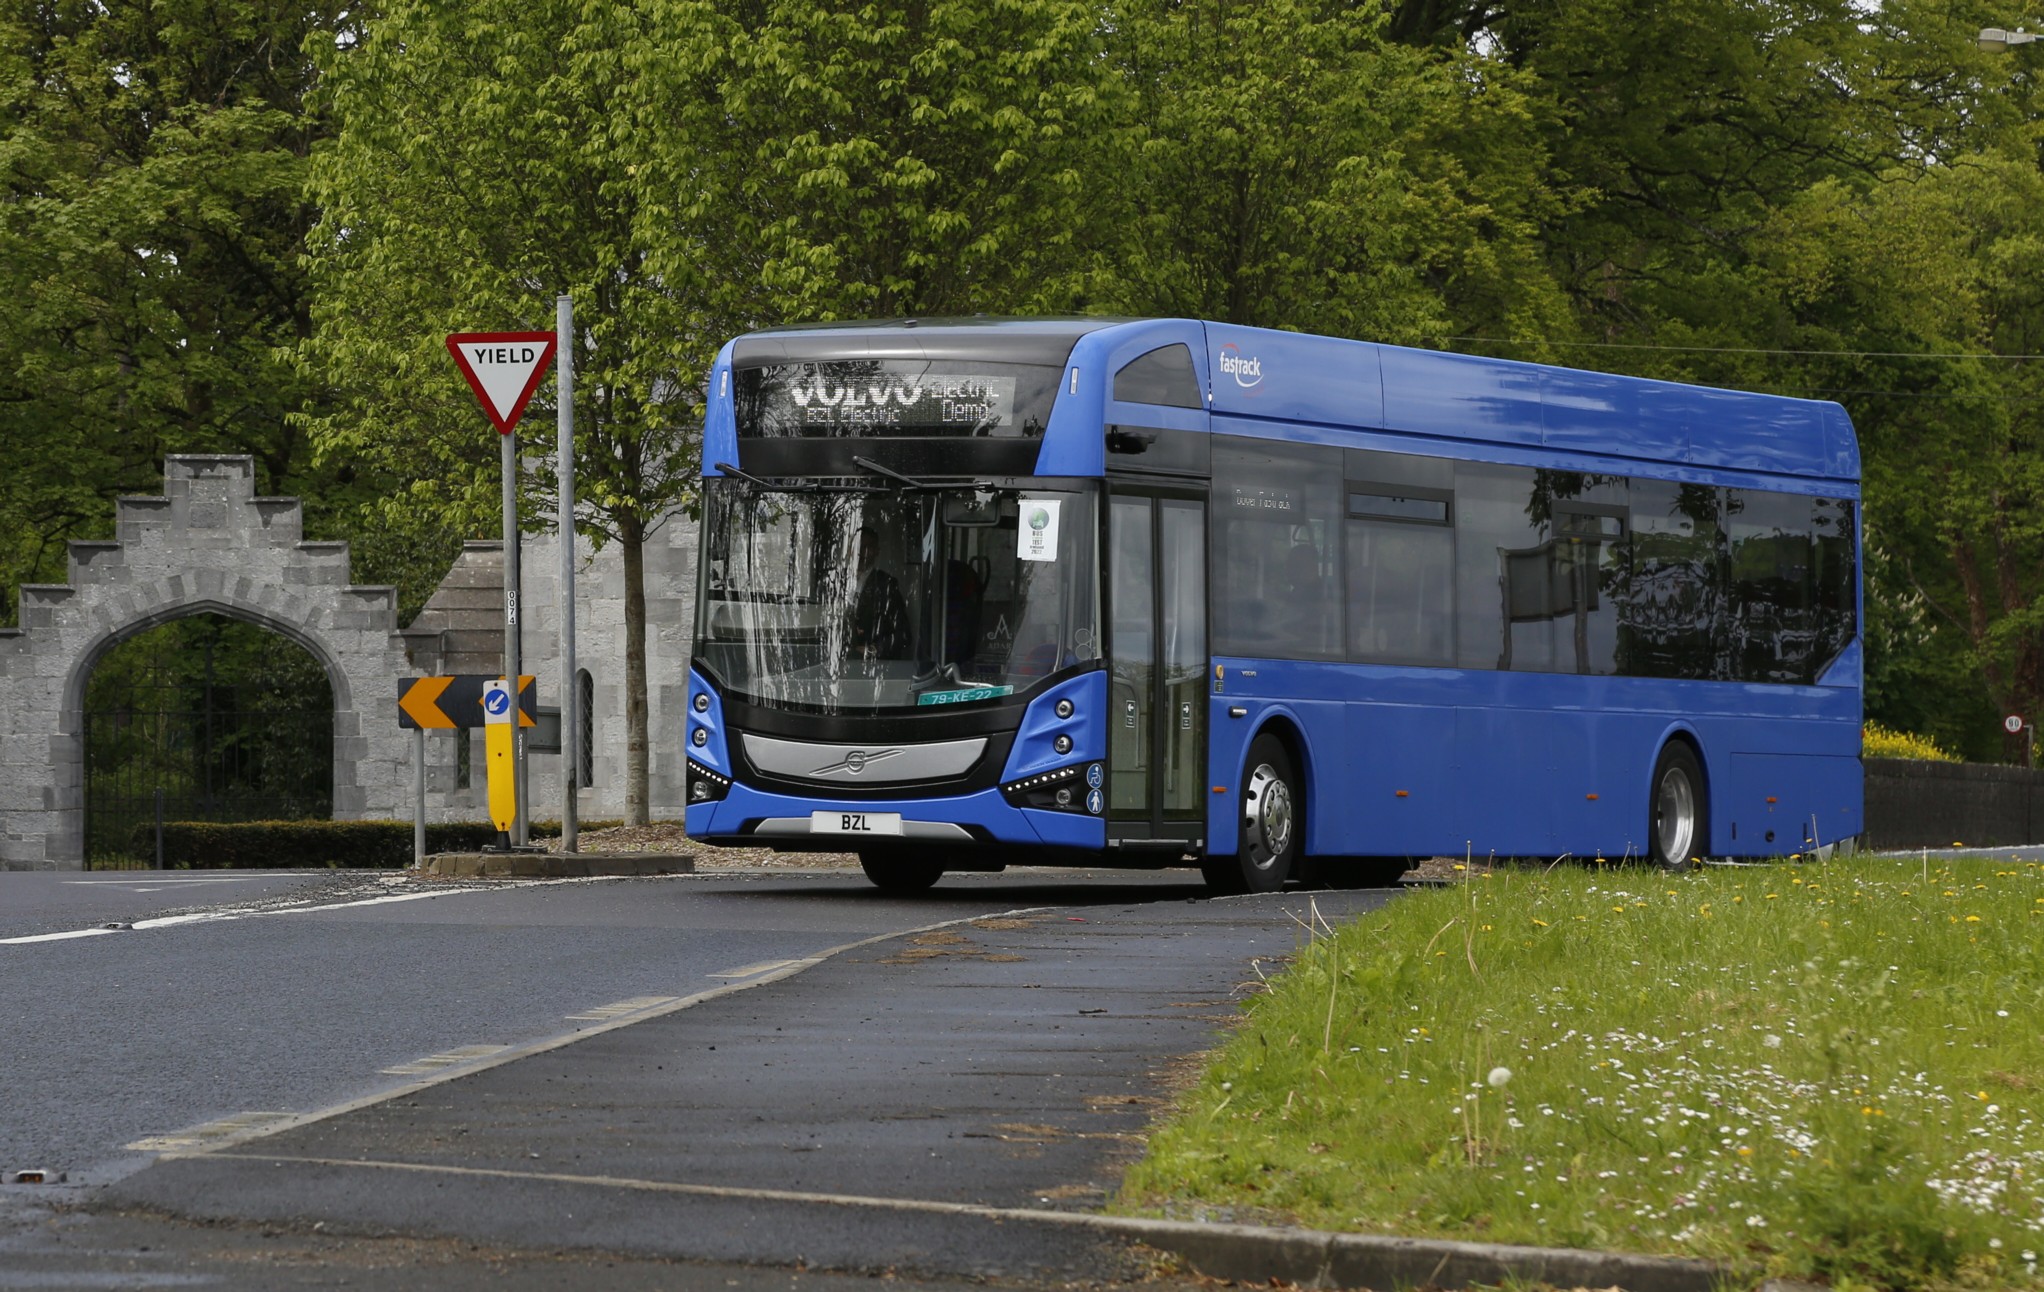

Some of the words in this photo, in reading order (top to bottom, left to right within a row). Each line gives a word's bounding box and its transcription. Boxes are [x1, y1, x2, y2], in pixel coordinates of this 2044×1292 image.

[474, 348, 535, 364] YIELD
[1220, 351, 1261, 378] fastrack
[931, 376, 1000, 398] Electric
[942, 400, 989, 422] Demo
[931, 690, 992, 704] 79-KE-22
[841, 814, 871, 831] BZL
